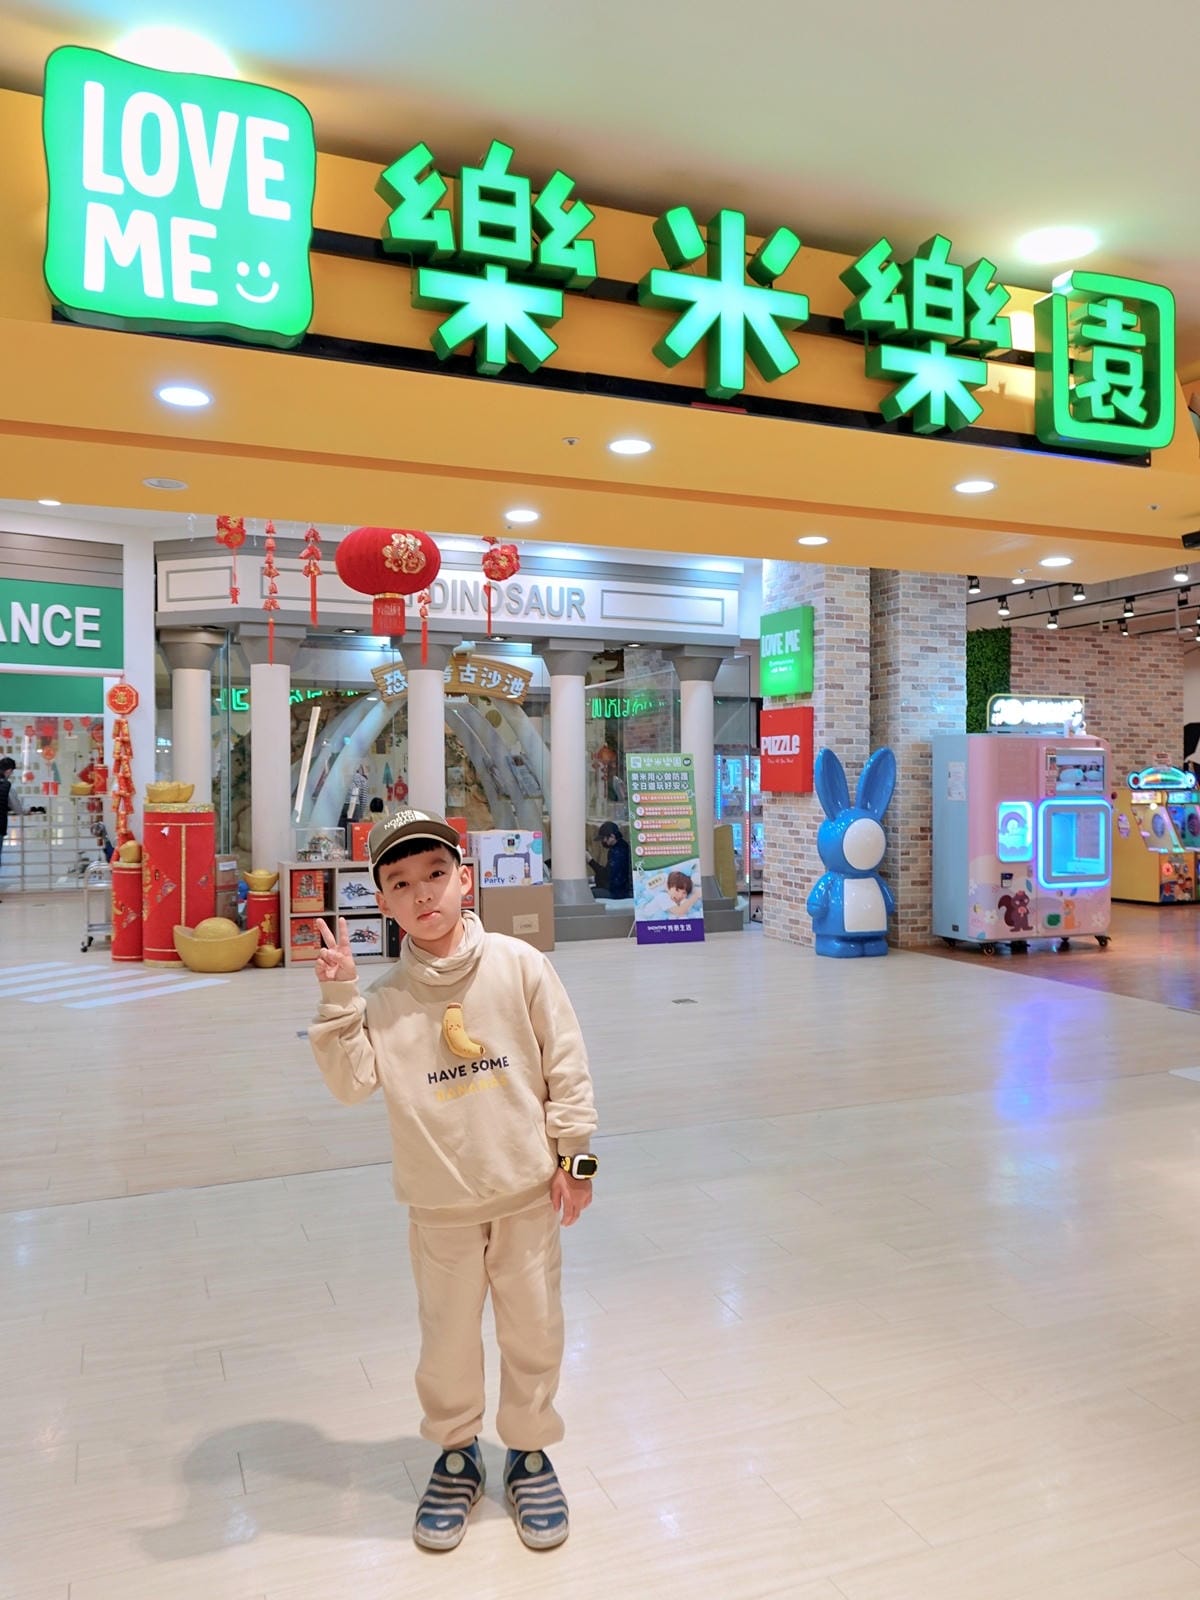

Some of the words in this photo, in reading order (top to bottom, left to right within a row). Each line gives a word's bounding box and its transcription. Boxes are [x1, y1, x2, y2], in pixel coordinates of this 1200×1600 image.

[82, 80, 292, 222] LOVE
[83, 203, 219, 307] ME
[376, 139, 1176, 450] 樂米樂園
[429, 578, 586, 619] DINOSAUR
[0, 601, 102, 649] NCE
[761, 632, 784, 658] LOVE
[484, 877, 506, 885] Party
[427, 1065, 468, 1084] HAVE
[471, 1056, 510, 1074] SOME
